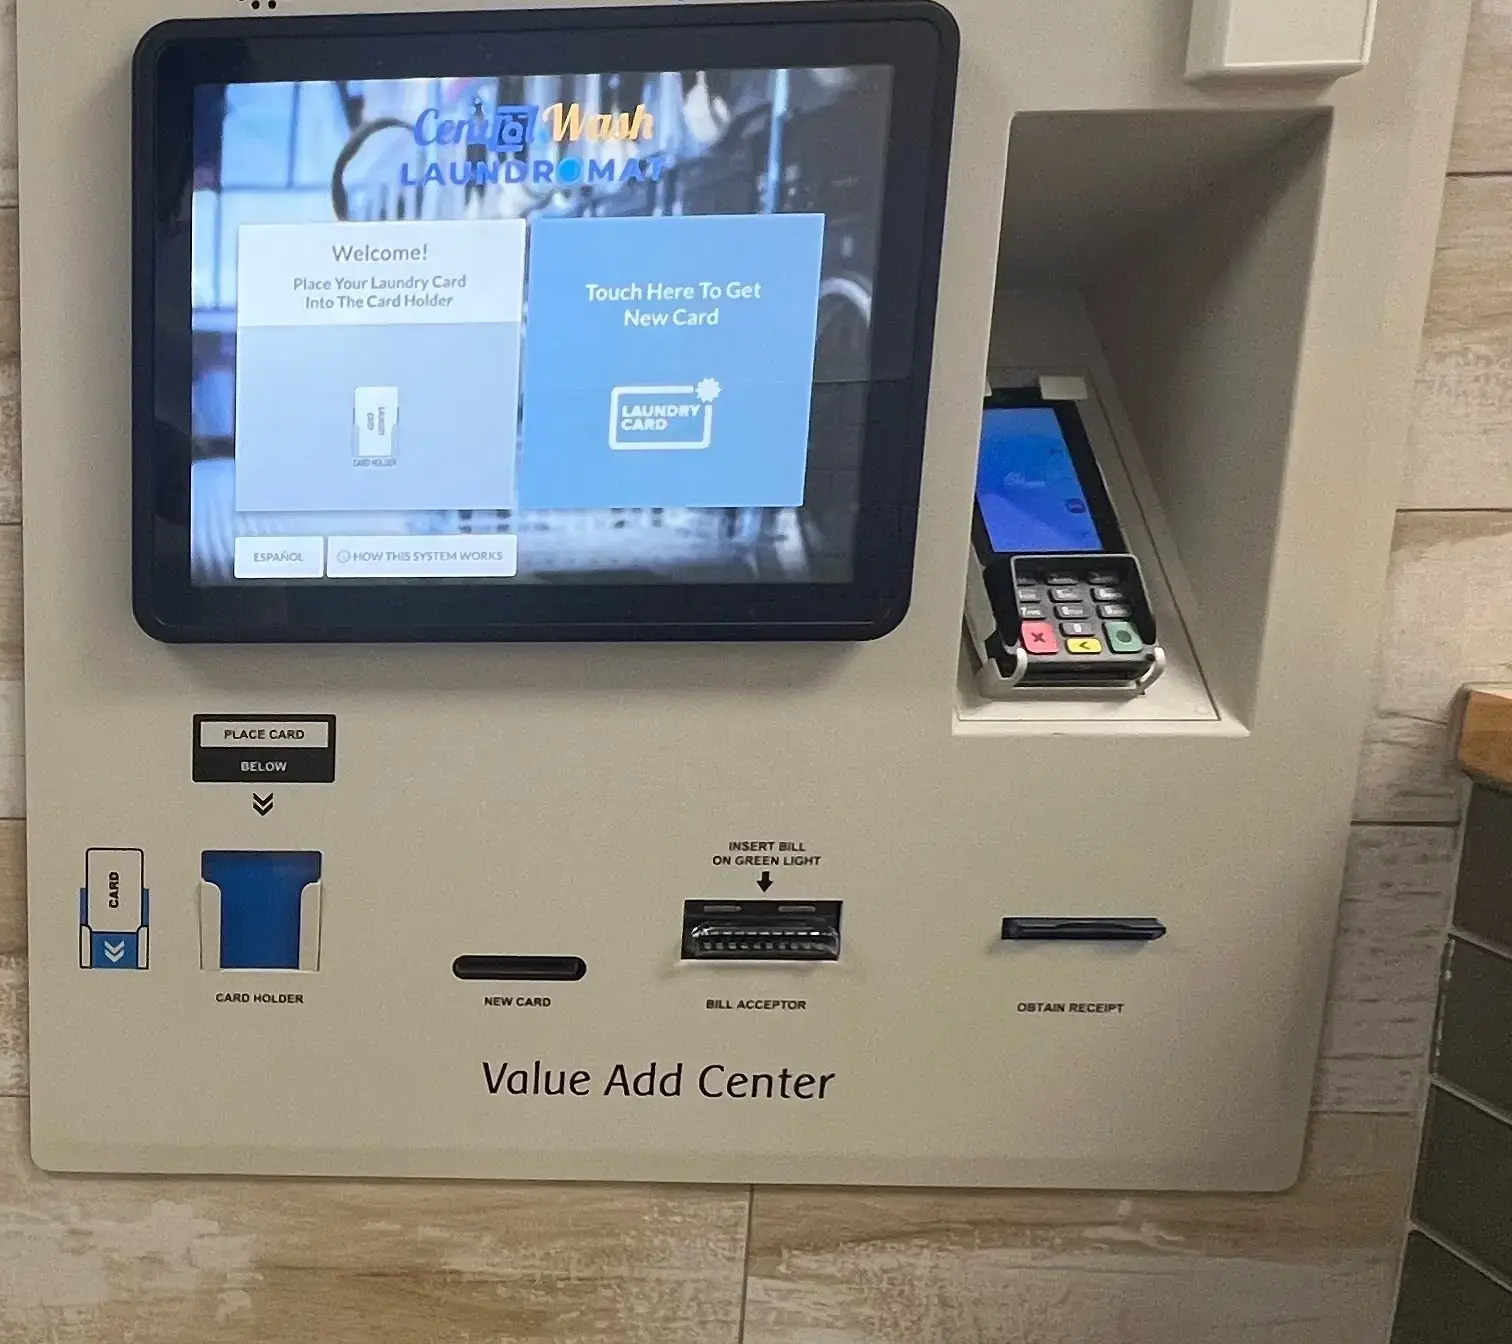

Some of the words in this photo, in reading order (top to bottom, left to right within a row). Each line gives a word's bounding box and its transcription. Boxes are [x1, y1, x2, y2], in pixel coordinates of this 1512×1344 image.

[543, 103, 655, 142] Wash
[332, 243, 428, 261] Welcome!
[293, 277, 332, 290] Place
[334, 277, 368, 290] Your
[370, 276, 429, 291] Laundry
[432, 275, 467, 288] Card
[585, 282, 642, 301] Touch
[646, 282, 695, 300] Here
[698, 281, 722, 299] To
[725, 281, 761, 299] Get
[305, 296, 334, 309] Into
[336, 295, 364, 308] The
[366, 294, 401, 307] Card
[404, 293, 454, 307] Holder
[624, 309, 668, 326] New
[672, 308, 719, 326] Card
[622, 405, 701, 417] LAUNDRY
[620, 419, 668, 431] CARD
[253, 550, 304, 562] ESPAÑOL
[353, 551, 382, 561] HOW
[385, 551, 411, 561] THIS
[413, 551, 457, 561] SYSTEM
[459, 550, 503, 561] WORKS
[224, 729, 265, 739] PLACE
[269, 729, 305, 739] CARD
[240, 761, 287, 772] BELOW
[729, 841, 775, 851] INSERT
[778, 842, 806, 851] BILL
[712, 855, 731, 865] ON
[734, 855, 779, 865] GREEN
[783, 856, 821, 865] LIGHT
[108, 871, 119, 908] CARD
[215, 993, 250, 1003] CARD
[253, 994, 304, 1004] HOLDER
[484, 996, 514, 1006] NEW
[516, 997, 551, 1007] CARD
[706, 999, 733, 1009] BILL
[737, 999, 807, 1010] ACCEPTOR
[1017, 1002, 1065, 1012] OBTAIN
[1068, 1002, 1125, 1013] RECEIPT
[482, 1060, 591, 1096] Value
[603, 1061, 683, 1097] Add
[698, 1064, 837, 1099] Center
